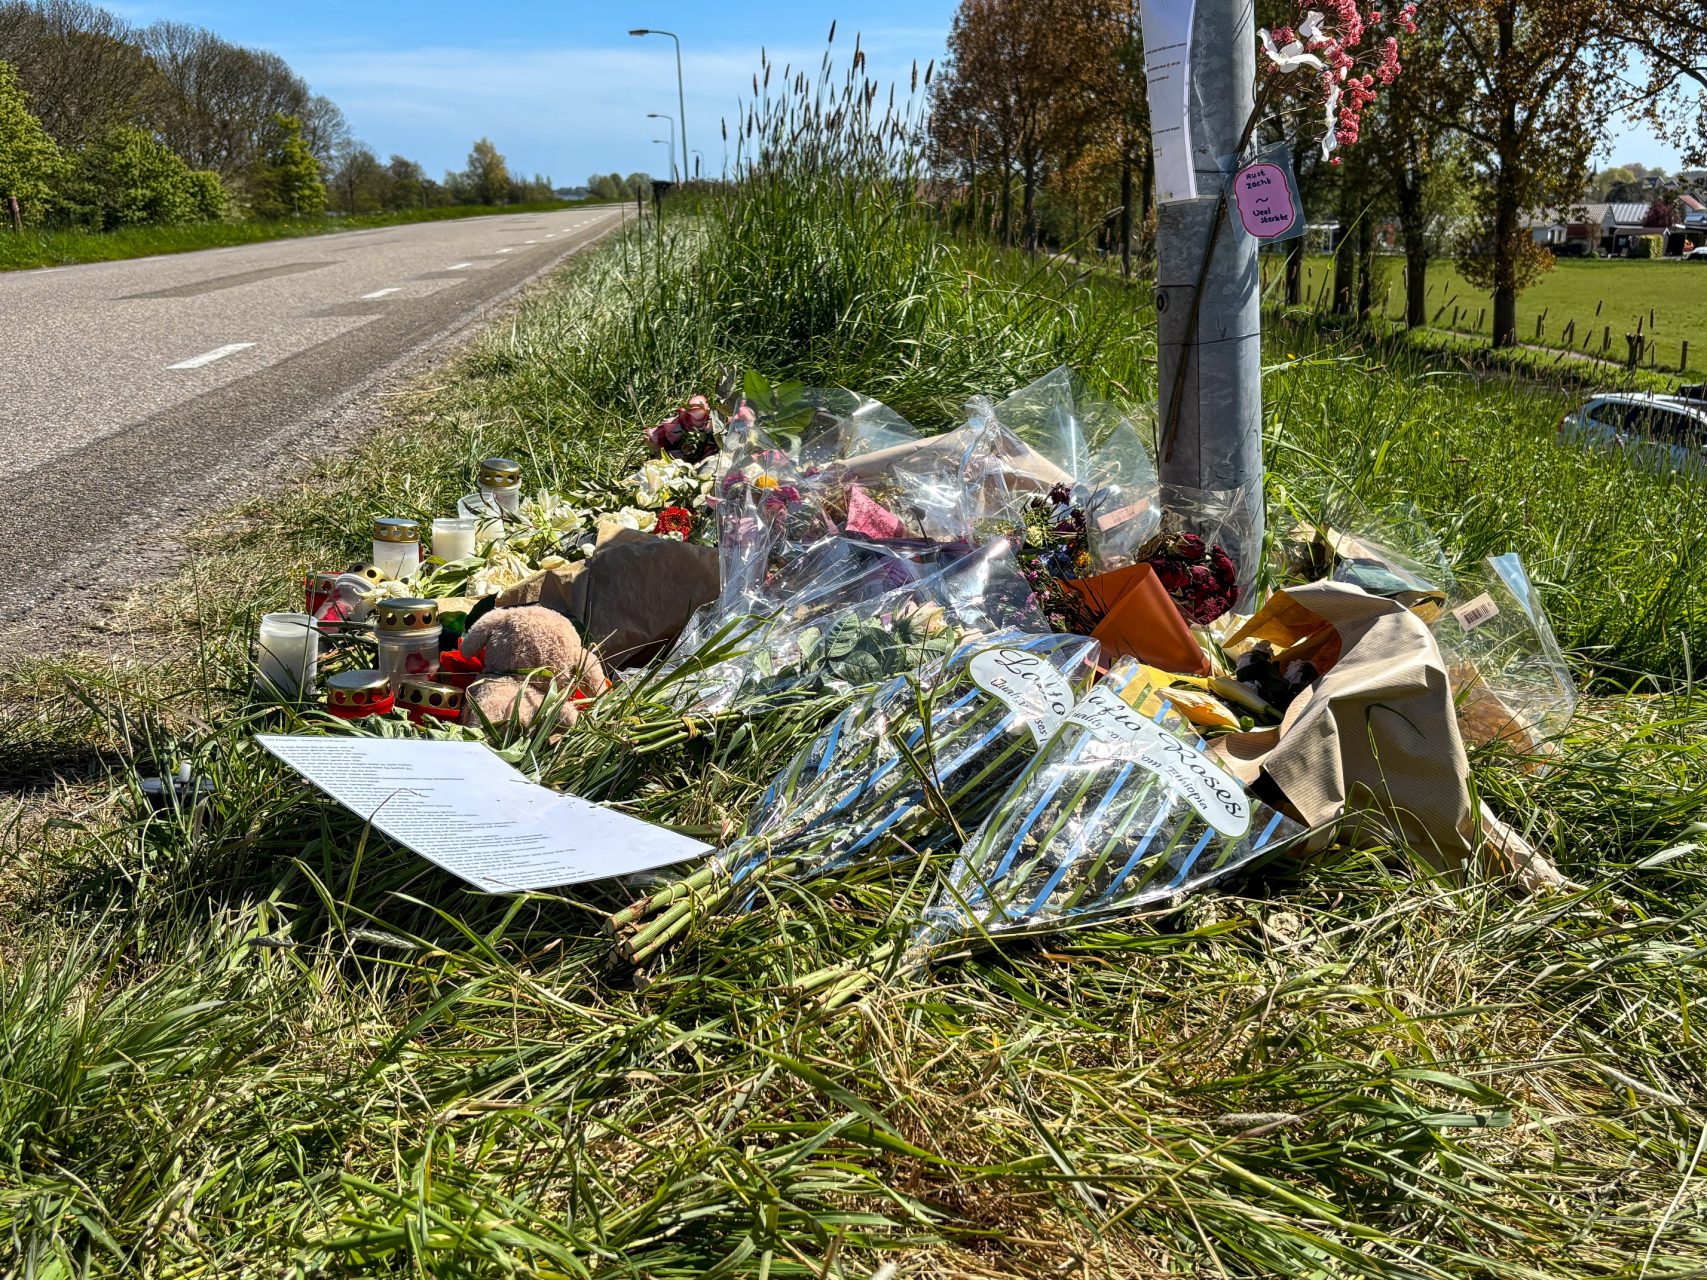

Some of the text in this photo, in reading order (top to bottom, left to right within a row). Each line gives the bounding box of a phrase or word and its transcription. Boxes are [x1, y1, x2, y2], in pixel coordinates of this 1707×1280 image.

[1073, 711, 1105, 730] uality
[1164, 765, 1209, 810] Ethiopia
[1088, 686, 1246, 819] afto Roses
